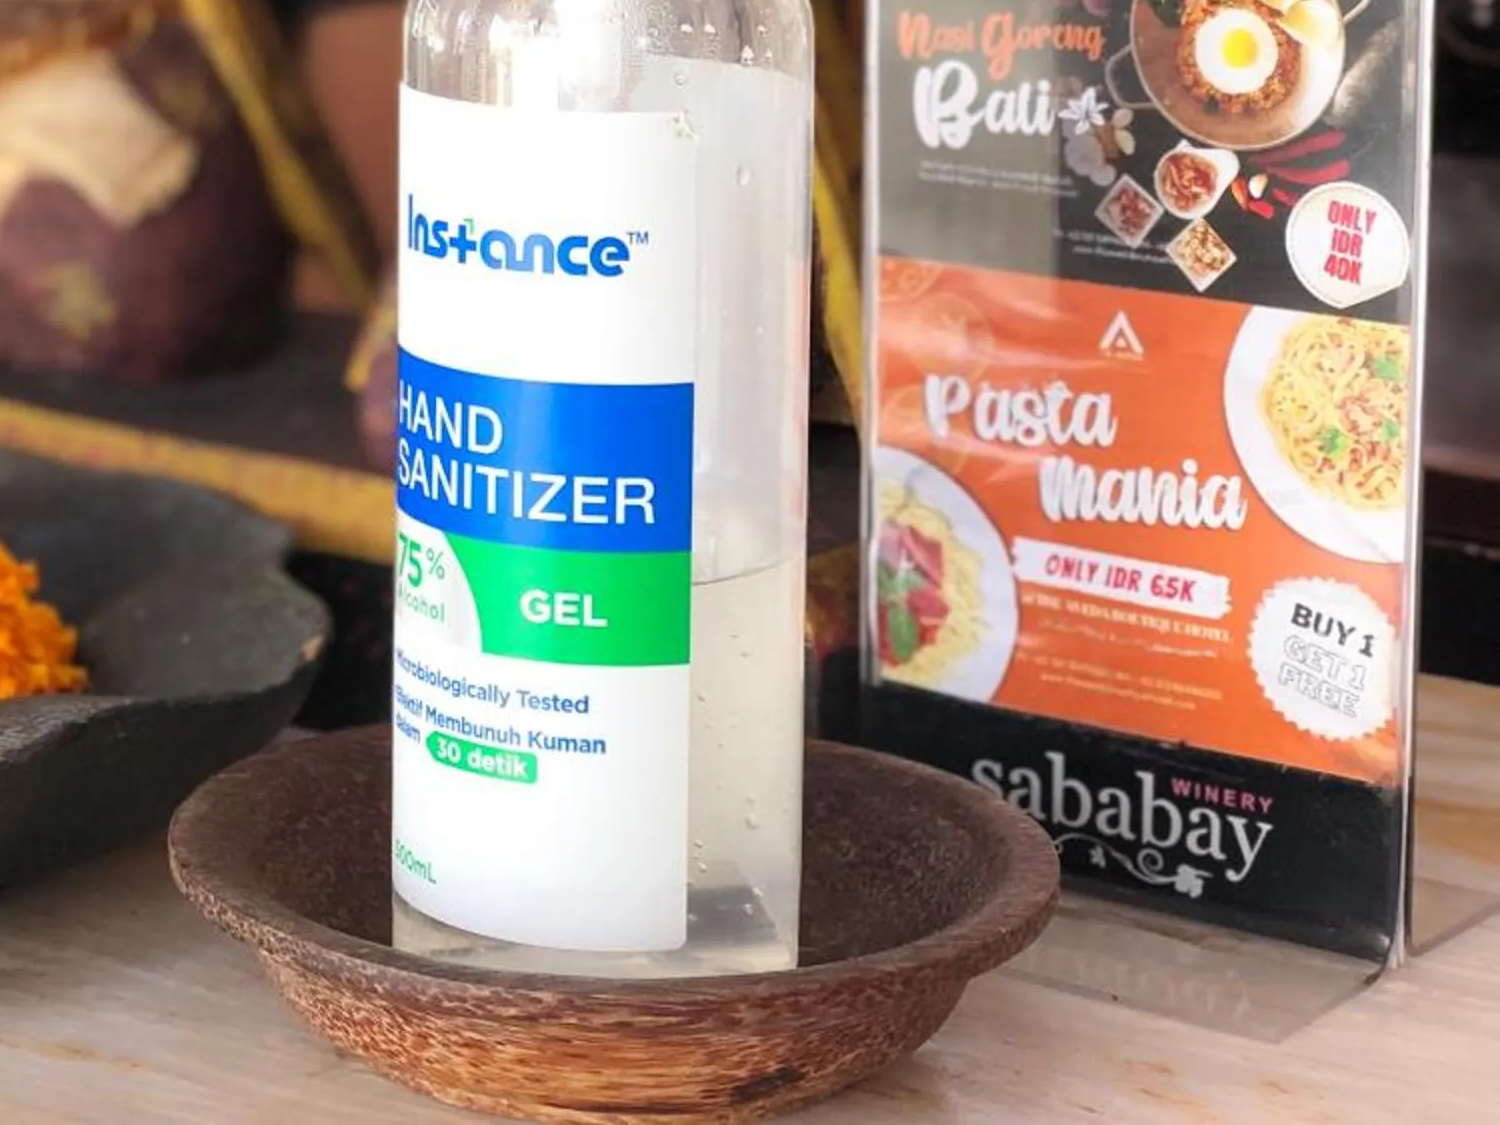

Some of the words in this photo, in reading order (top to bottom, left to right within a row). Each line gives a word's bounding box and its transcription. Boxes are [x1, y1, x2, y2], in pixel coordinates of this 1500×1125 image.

[913, 60, 1055, 149] Bali
[1328, 200, 1377, 234] ONLY
[1332, 228, 1363, 257] IDR
[1324, 254, 1362, 285] 40K
[399, 378, 503, 455] HAND
[924, 374, 1118, 448] Pasta
[398, 437, 655, 525] SANITIZER
[1045, 555, 1098, 583] ONLY
[1104, 565, 1142, 592] IDR
[1151, 573, 1197, 603] 65K
[520, 589, 608, 628] GEL
[1290, 603, 1356, 645] BUY
[1359, 634, 1374, 657] 1
[1284, 635, 1347, 679] GET
[1348, 664, 1366, 691] 1
[516, 689, 589, 714] Tested
[1278, 662, 1360, 717] FREE
[426, 705, 521, 745] Membunuh
[528, 730, 606, 754] Kuman
[435, 739, 461, 763] 30
[467, 748, 529, 777] detik
[1170, 776, 1274, 815] WINERY
